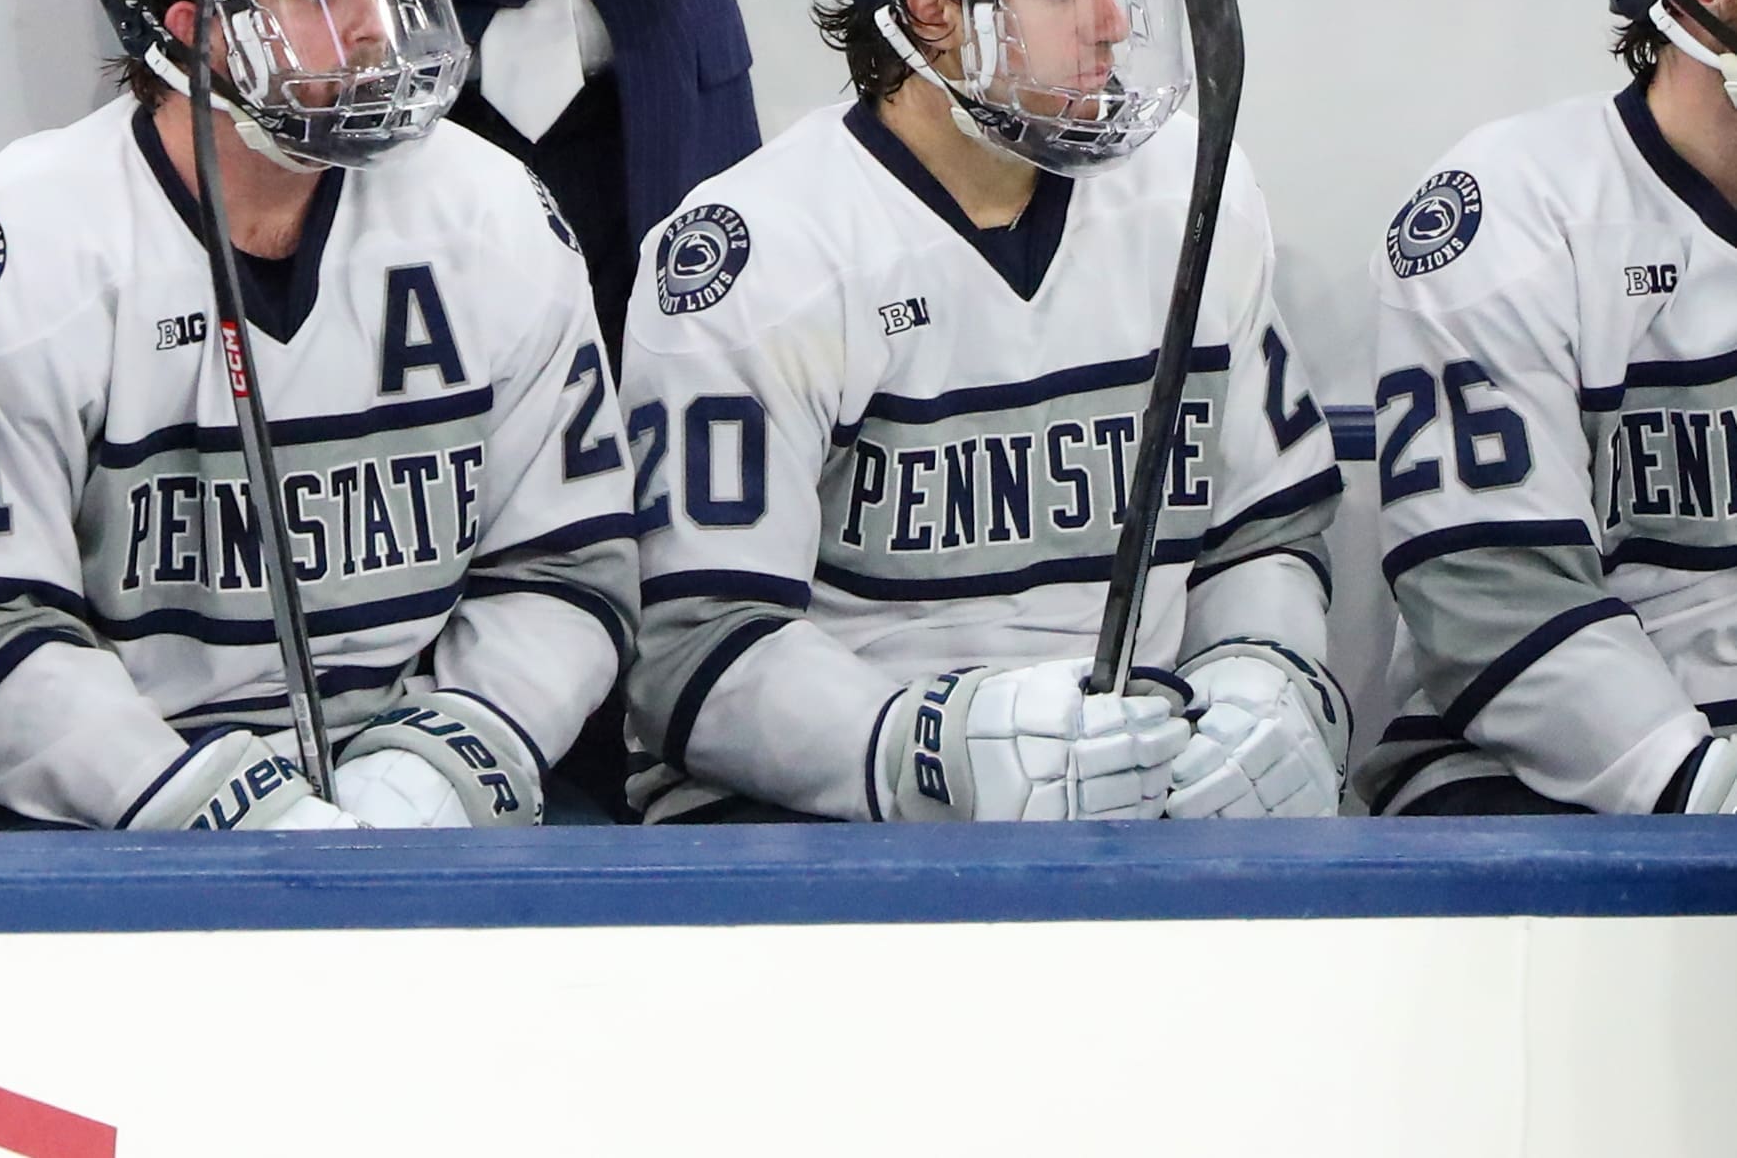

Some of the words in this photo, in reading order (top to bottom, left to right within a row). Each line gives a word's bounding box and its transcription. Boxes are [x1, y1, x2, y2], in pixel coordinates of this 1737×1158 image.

[711, 206, 749, 251] STATE
[1415, 237, 1465, 274] LIONS
[376, 260, 470, 396] A
[686, 270, 735, 312] LIONS
[222, 326, 248, 393] CCM
[628, 394, 767, 532] 20
[1375, 356, 1535, 512] 26
[838, 430, 1035, 555] PENN
